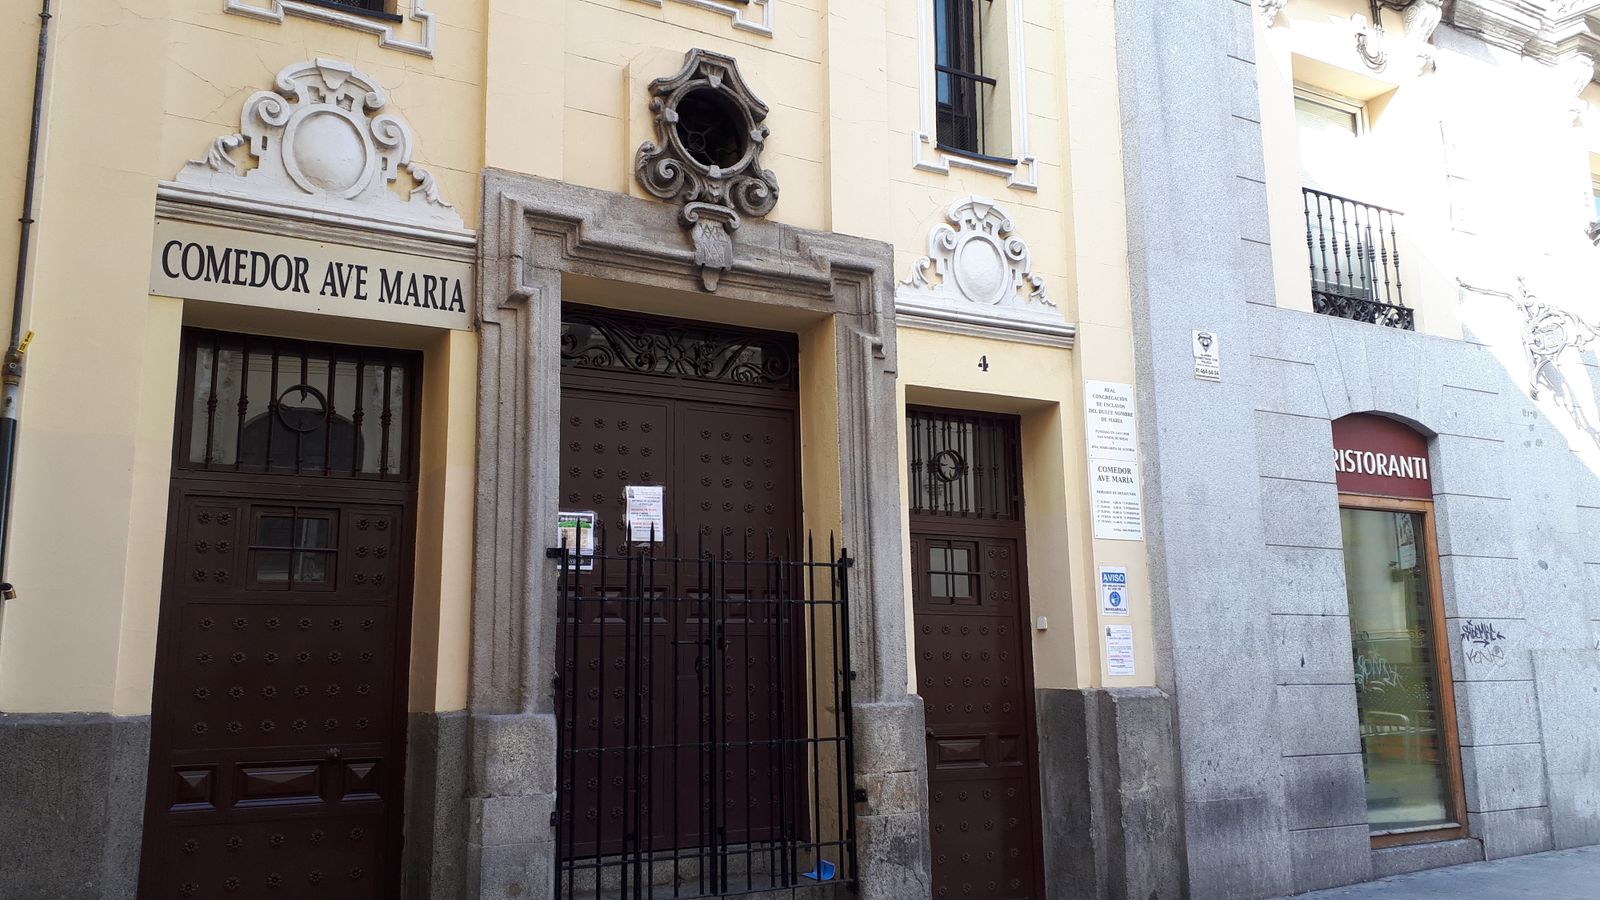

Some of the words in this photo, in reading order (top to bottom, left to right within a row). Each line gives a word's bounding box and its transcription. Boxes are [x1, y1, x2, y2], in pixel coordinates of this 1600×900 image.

[162, 240, 310, 294] COMEDOR
[320, 261, 368, 300] AVE
[378, 268, 466, 313] MARIA
[978, 355, 989, 372] 4
[1092, 394, 1128, 402] CONGREGACIÓN
[1098, 466, 1132, 475] COMEDOR
[1103, 574, 1124, 582] AVISO
